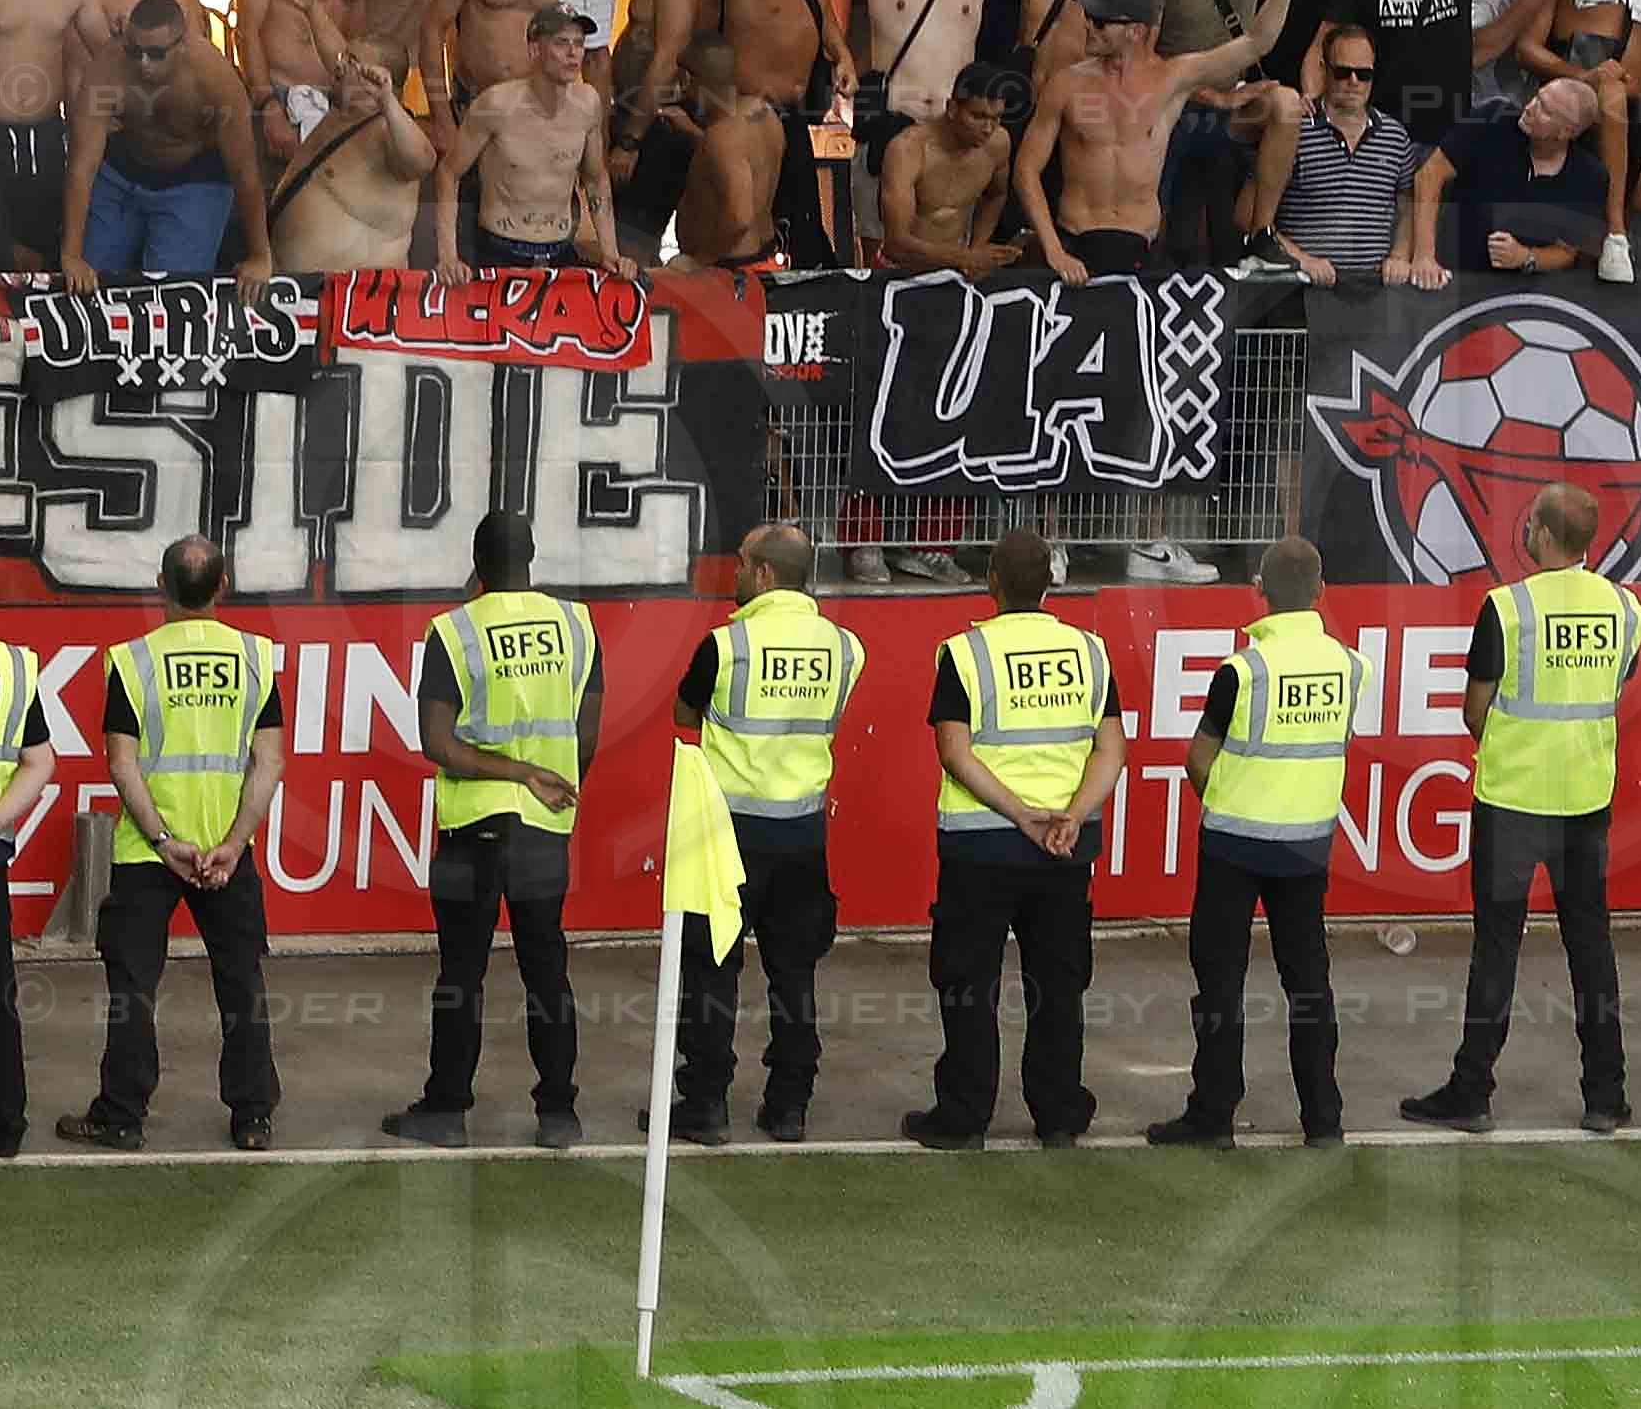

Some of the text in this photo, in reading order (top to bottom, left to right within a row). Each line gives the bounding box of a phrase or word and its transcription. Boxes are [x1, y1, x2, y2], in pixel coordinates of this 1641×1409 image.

[499, 630, 552, 659] BFS
[1558, 625, 1609, 649] BFS
[495, 661, 563, 679] SECURITY
[773, 658, 823, 681] BFS
[1546, 653, 1614, 668] SECURITY
[175, 662, 229, 689] BFS
[1018, 660, 1075, 687] BFS
[168, 693, 237, 708] SECURITY
[761, 685, 828, 699] SECURITY
[1010, 693, 1084, 709] SECURITY
[1289, 683, 1334, 707] BFS
[1277, 710, 1341, 725] SECURITY
